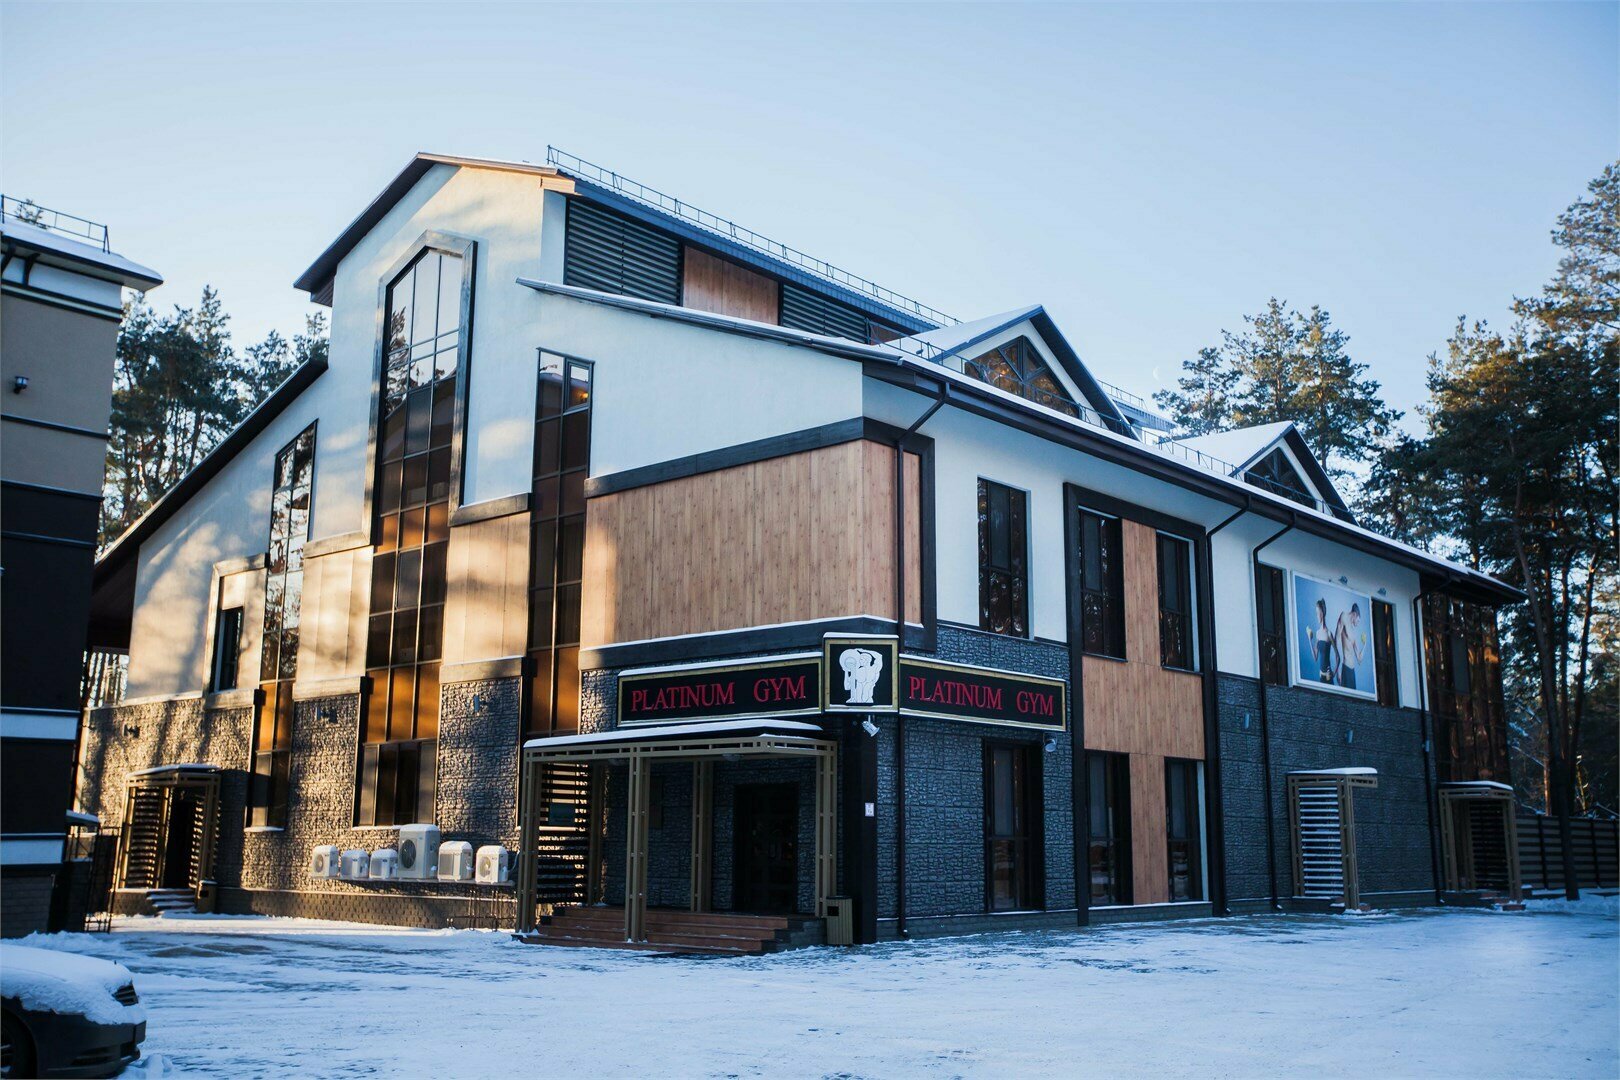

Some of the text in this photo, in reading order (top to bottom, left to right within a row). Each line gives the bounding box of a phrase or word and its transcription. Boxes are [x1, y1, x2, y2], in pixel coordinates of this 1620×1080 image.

[631, 675, 806, 712] PLATINUM GYM
[909, 676, 1054, 716] PLATINUM GYM
